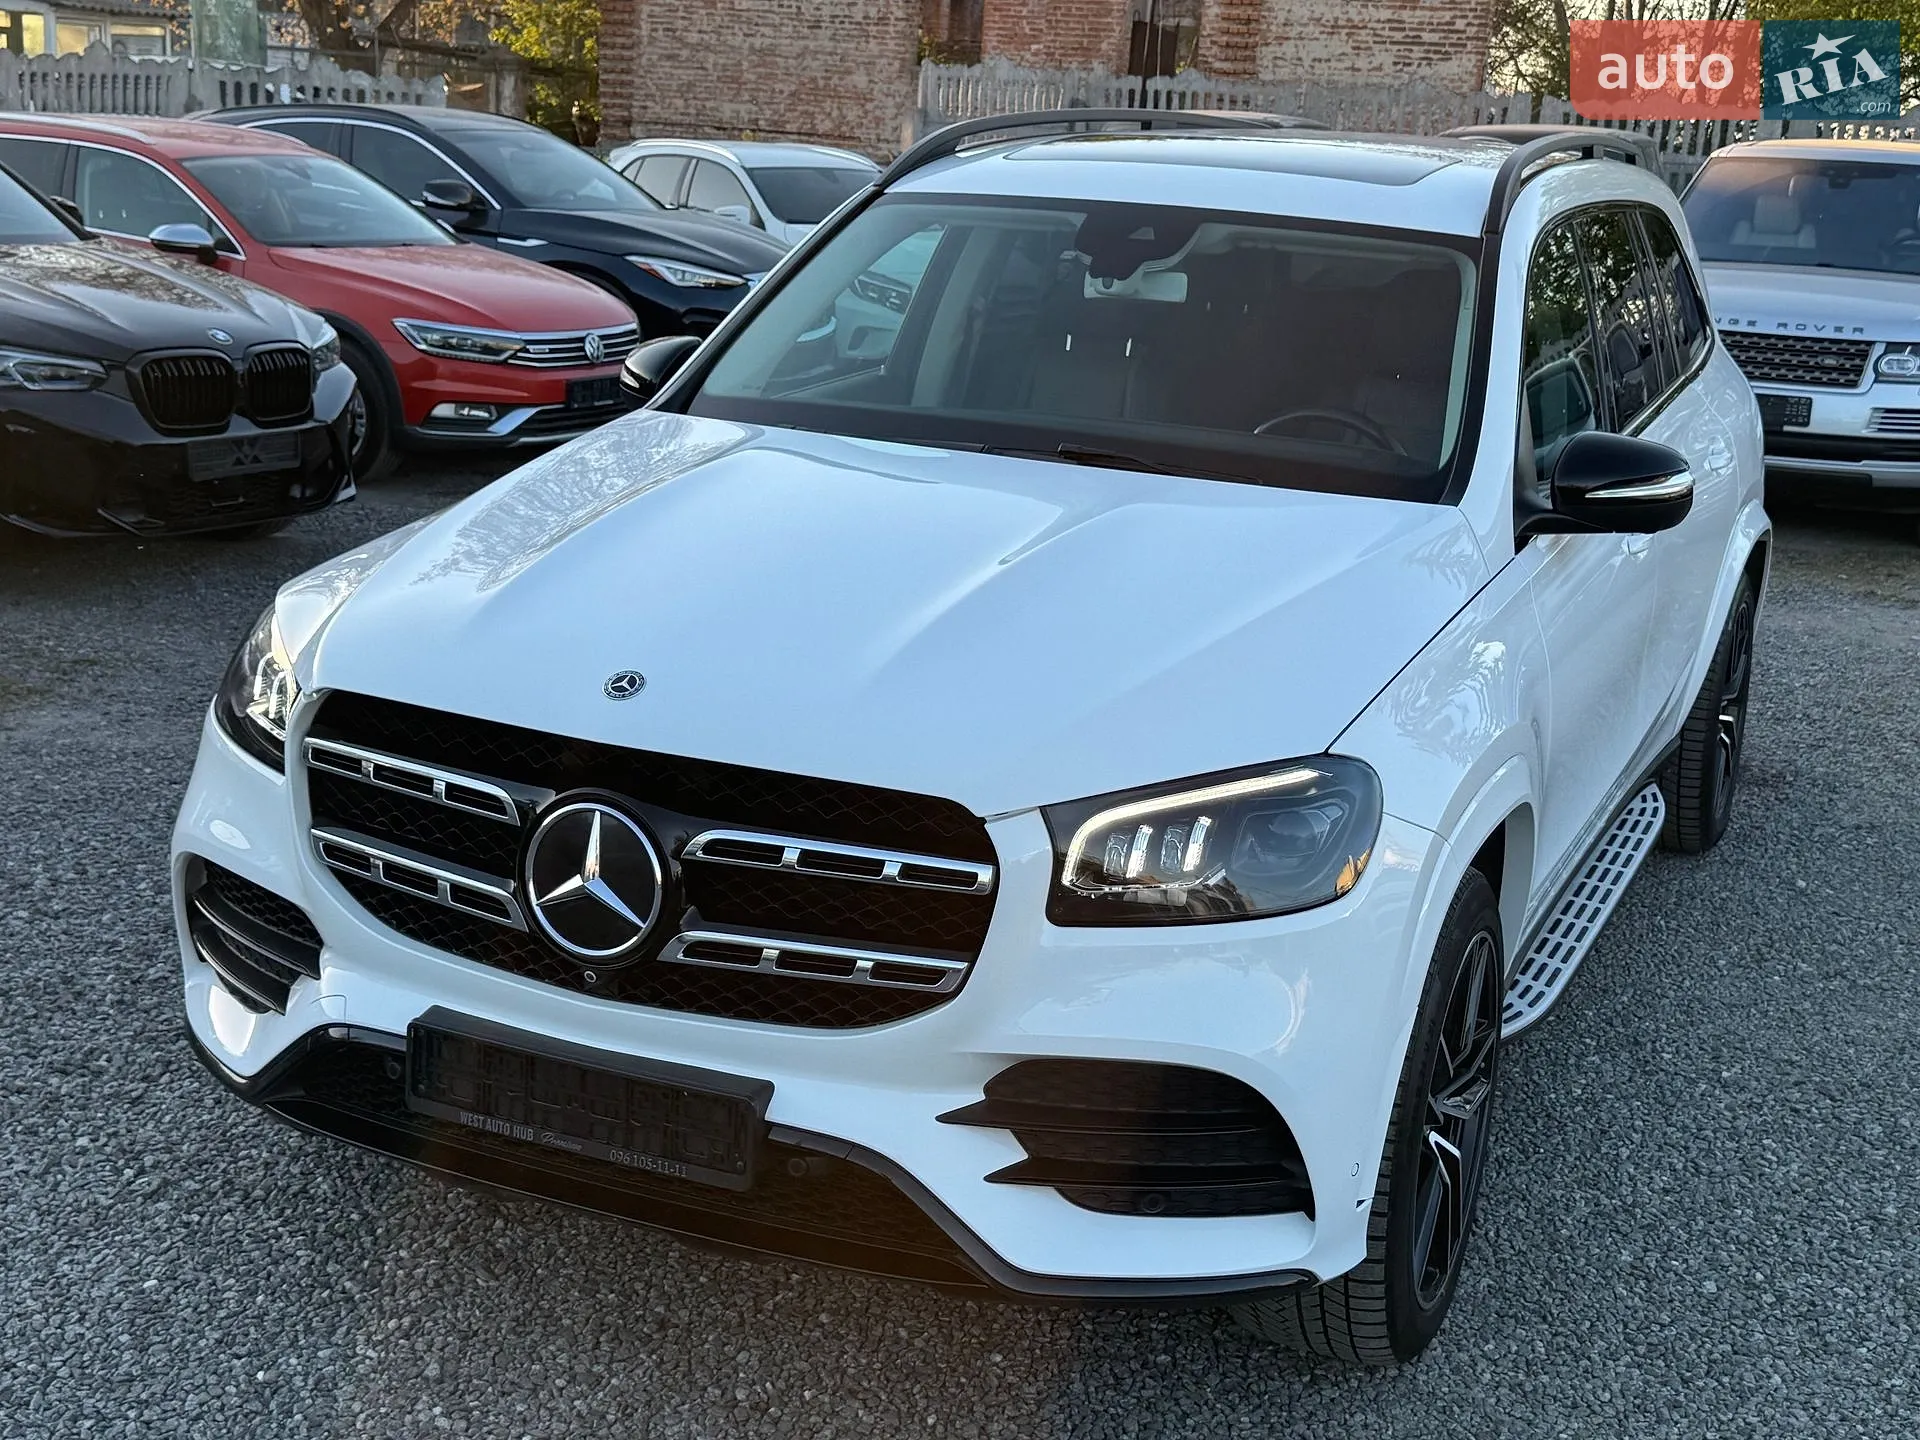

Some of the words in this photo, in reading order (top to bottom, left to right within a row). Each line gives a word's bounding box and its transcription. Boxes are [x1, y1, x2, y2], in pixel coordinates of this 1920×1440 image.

[1714, 317, 1758, 327] NGE
[1776, 322, 1865, 334] ROVER
[460, 1111, 484, 1129] WEST
[485, 1118, 510, 1136] AUTO
[513, 1124, 534, 1141] HUB
[610, 1149, 631, 1164] 096
